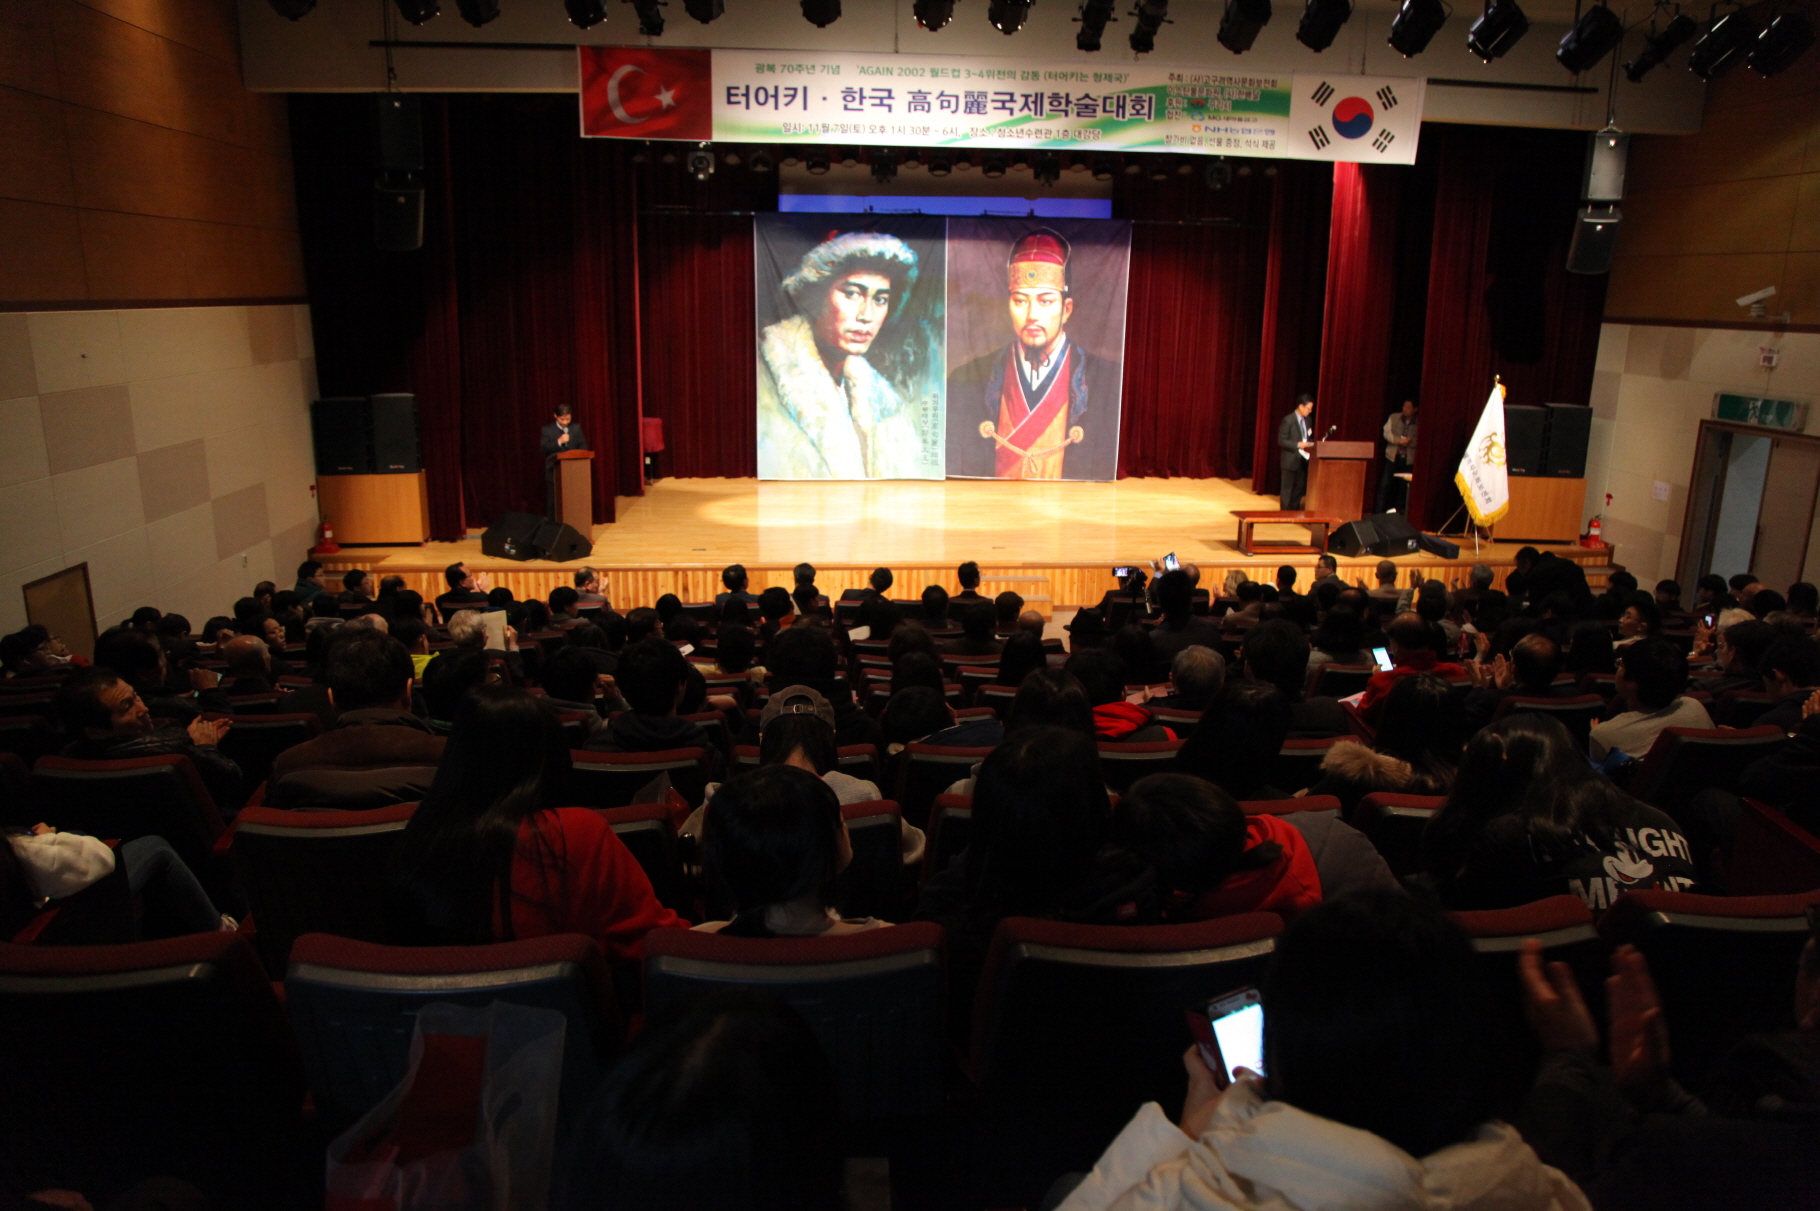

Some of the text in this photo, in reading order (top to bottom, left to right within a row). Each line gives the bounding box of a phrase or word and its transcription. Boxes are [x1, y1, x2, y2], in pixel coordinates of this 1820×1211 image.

[755, 63, 776, 74] 광복
[780, 63, 816, 75] 70주년
[820, 64, 841, 75] 기념
[897, 67, 926, 77] 2002
[930, 68, 961, 78] 월드컵
[1020, 70, 1041, 81] 감동
[726, 84, 808, 111] 터어키
[841, 86, 895, 113] 한국
[869, 125, 887, 134] 오후
[891, 125, 906, 135] 1시
[910, 126, 931, 136] 30분
[1056, 129, 1071, 140] 1층
[1262, 139, 1276, 150] 제공
